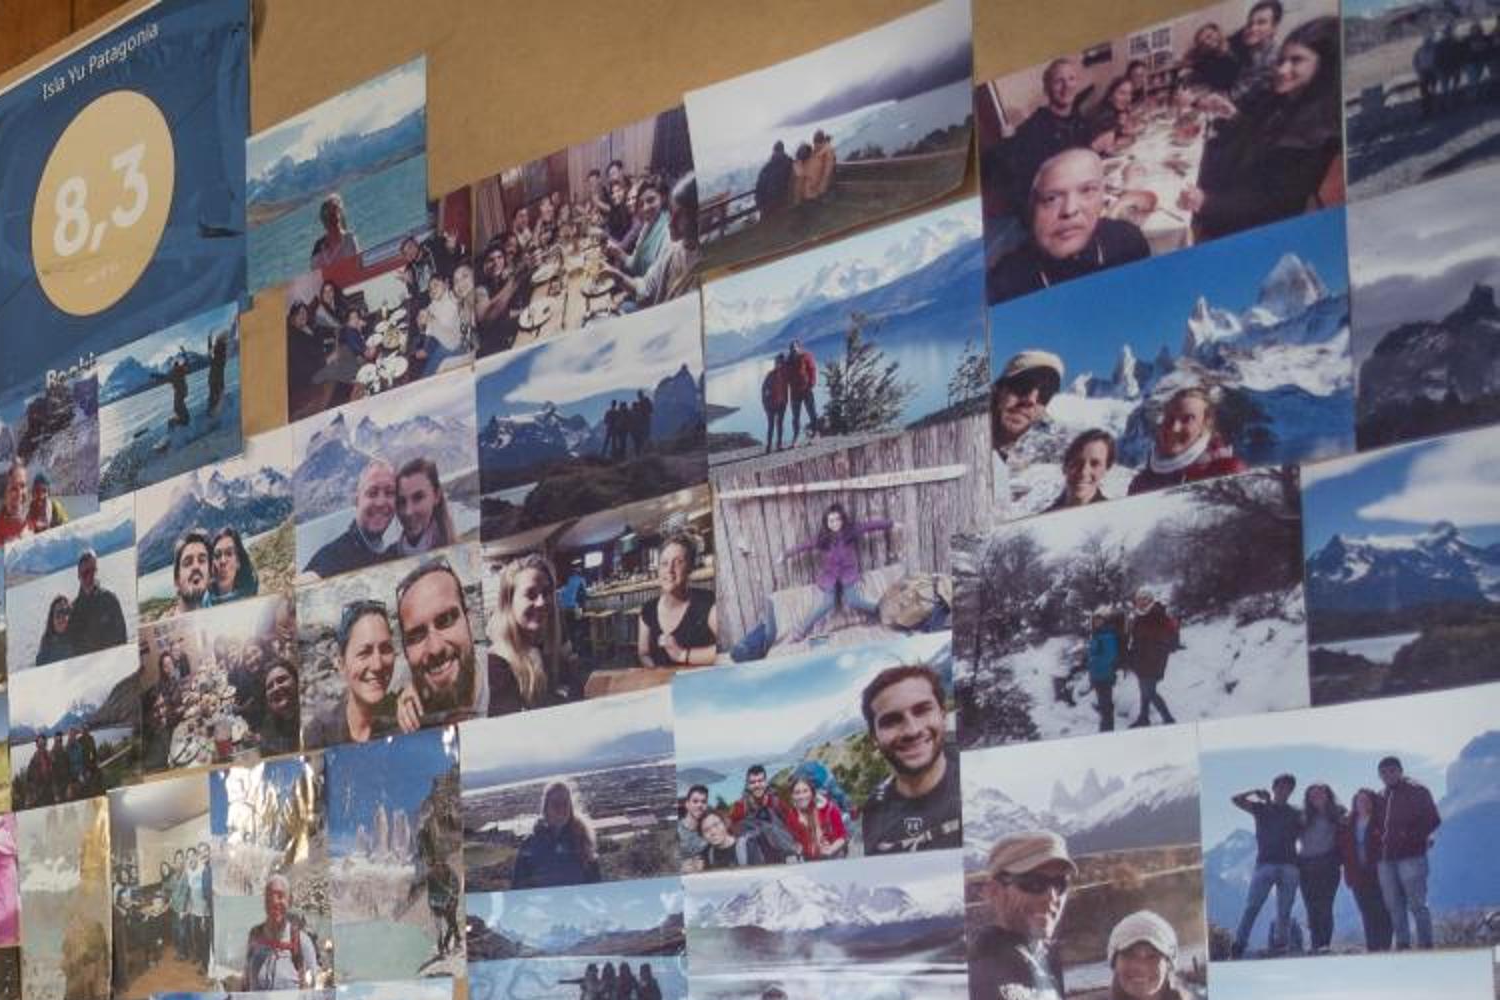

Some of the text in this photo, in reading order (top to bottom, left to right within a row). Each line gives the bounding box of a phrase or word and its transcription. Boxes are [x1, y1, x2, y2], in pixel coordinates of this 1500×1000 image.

[41, 22, 159, 101] Isla Yu Patagonia
[54, 143, 148, 256] 8,3
